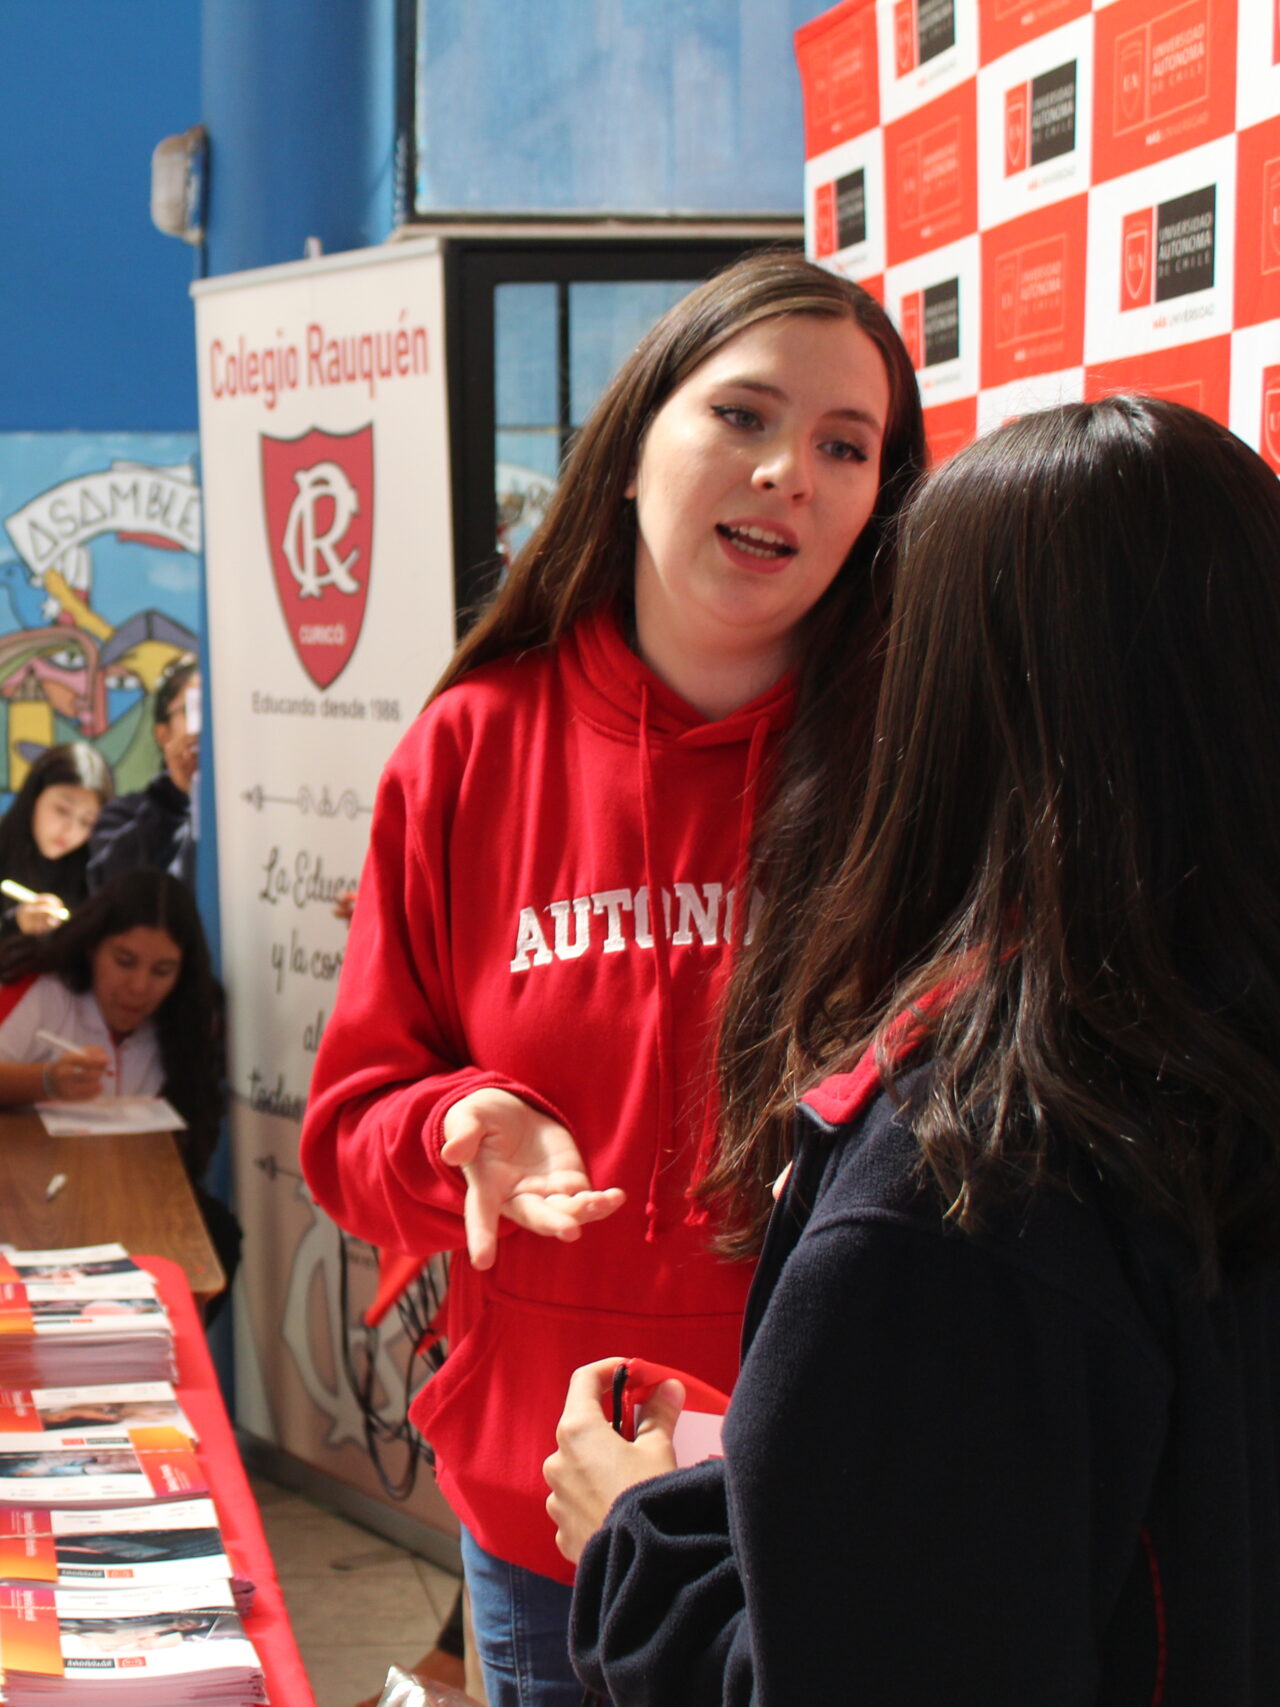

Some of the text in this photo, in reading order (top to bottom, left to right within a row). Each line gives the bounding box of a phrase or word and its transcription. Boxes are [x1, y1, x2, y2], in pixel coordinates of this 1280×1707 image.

[1157, 229, 1212, 262] AUTONOMA
[210, 309, 430, 411] Colegio Rauquén
[252, 691, 316, 716] Educando
[320, 697, 366, 719] desde
[259, 847, 288, 905] La
